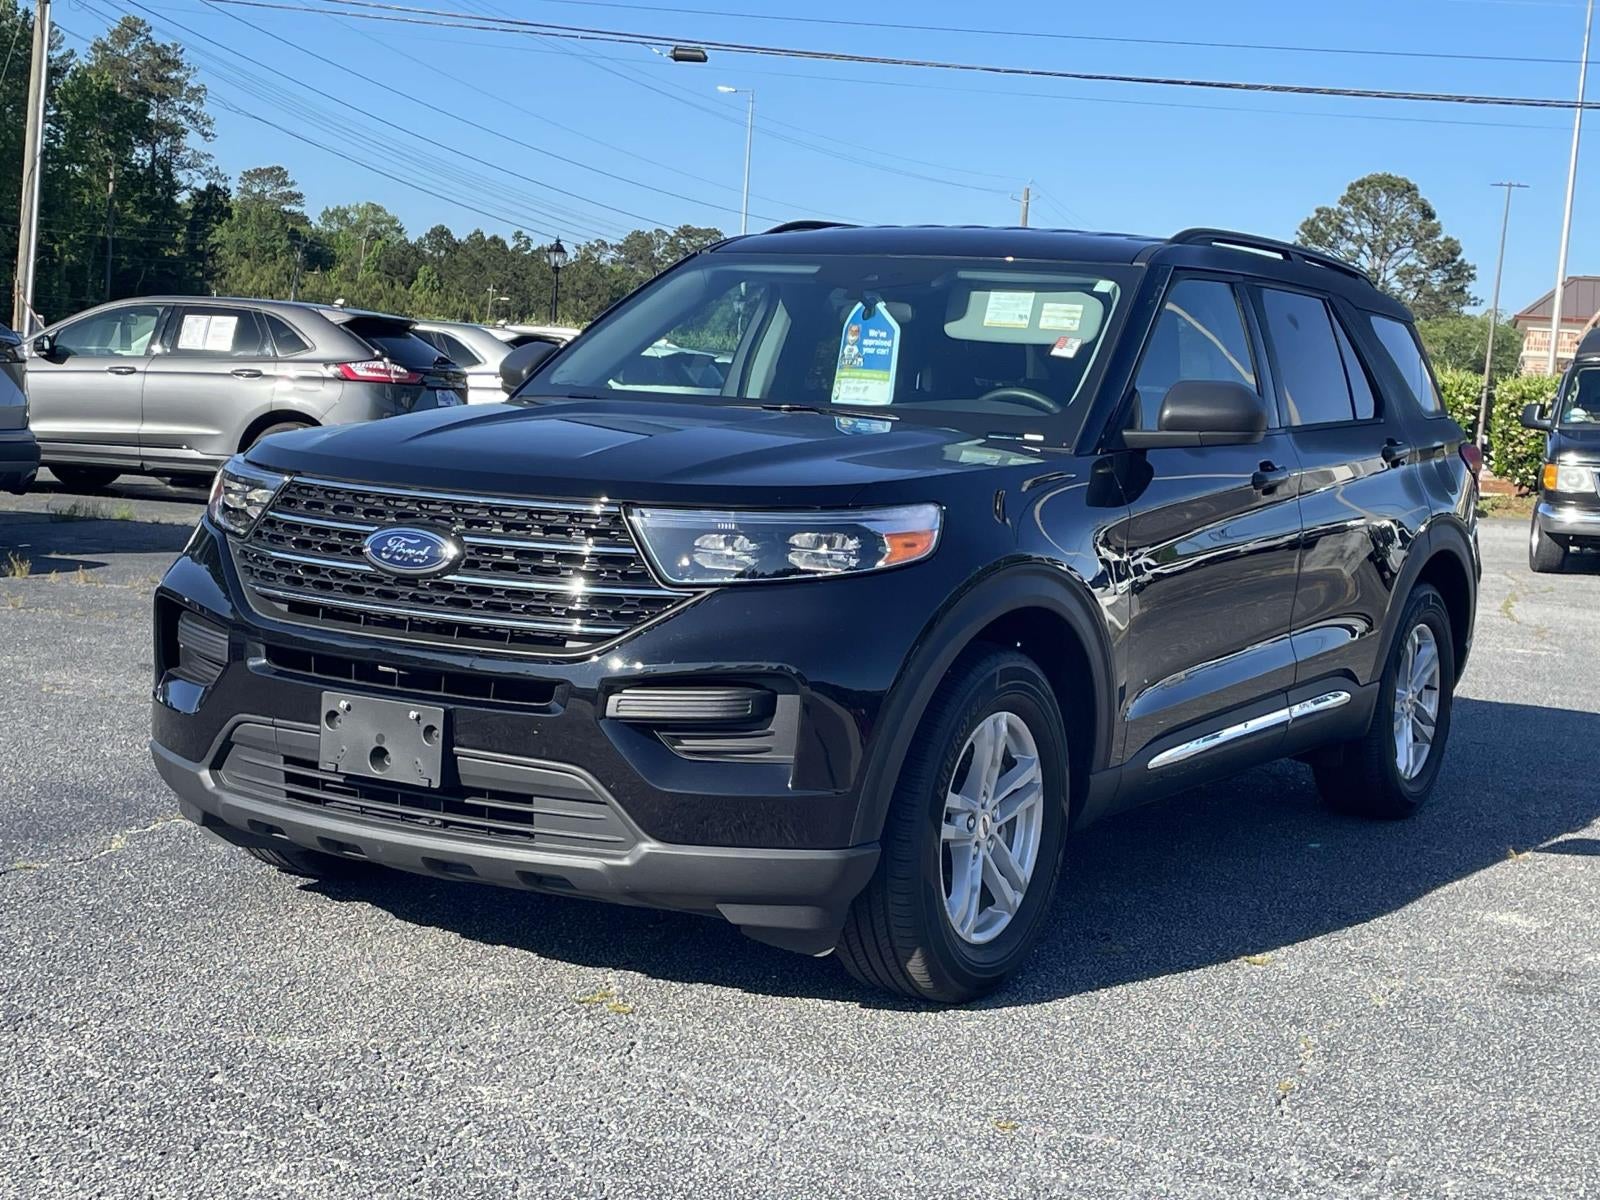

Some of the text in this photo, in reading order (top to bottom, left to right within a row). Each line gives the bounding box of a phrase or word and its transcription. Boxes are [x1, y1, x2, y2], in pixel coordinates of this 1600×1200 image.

[868, 329, 887, 338] We've
[862, 338, 892, 348] appraised
[381, 535, 432, 563] Ford
